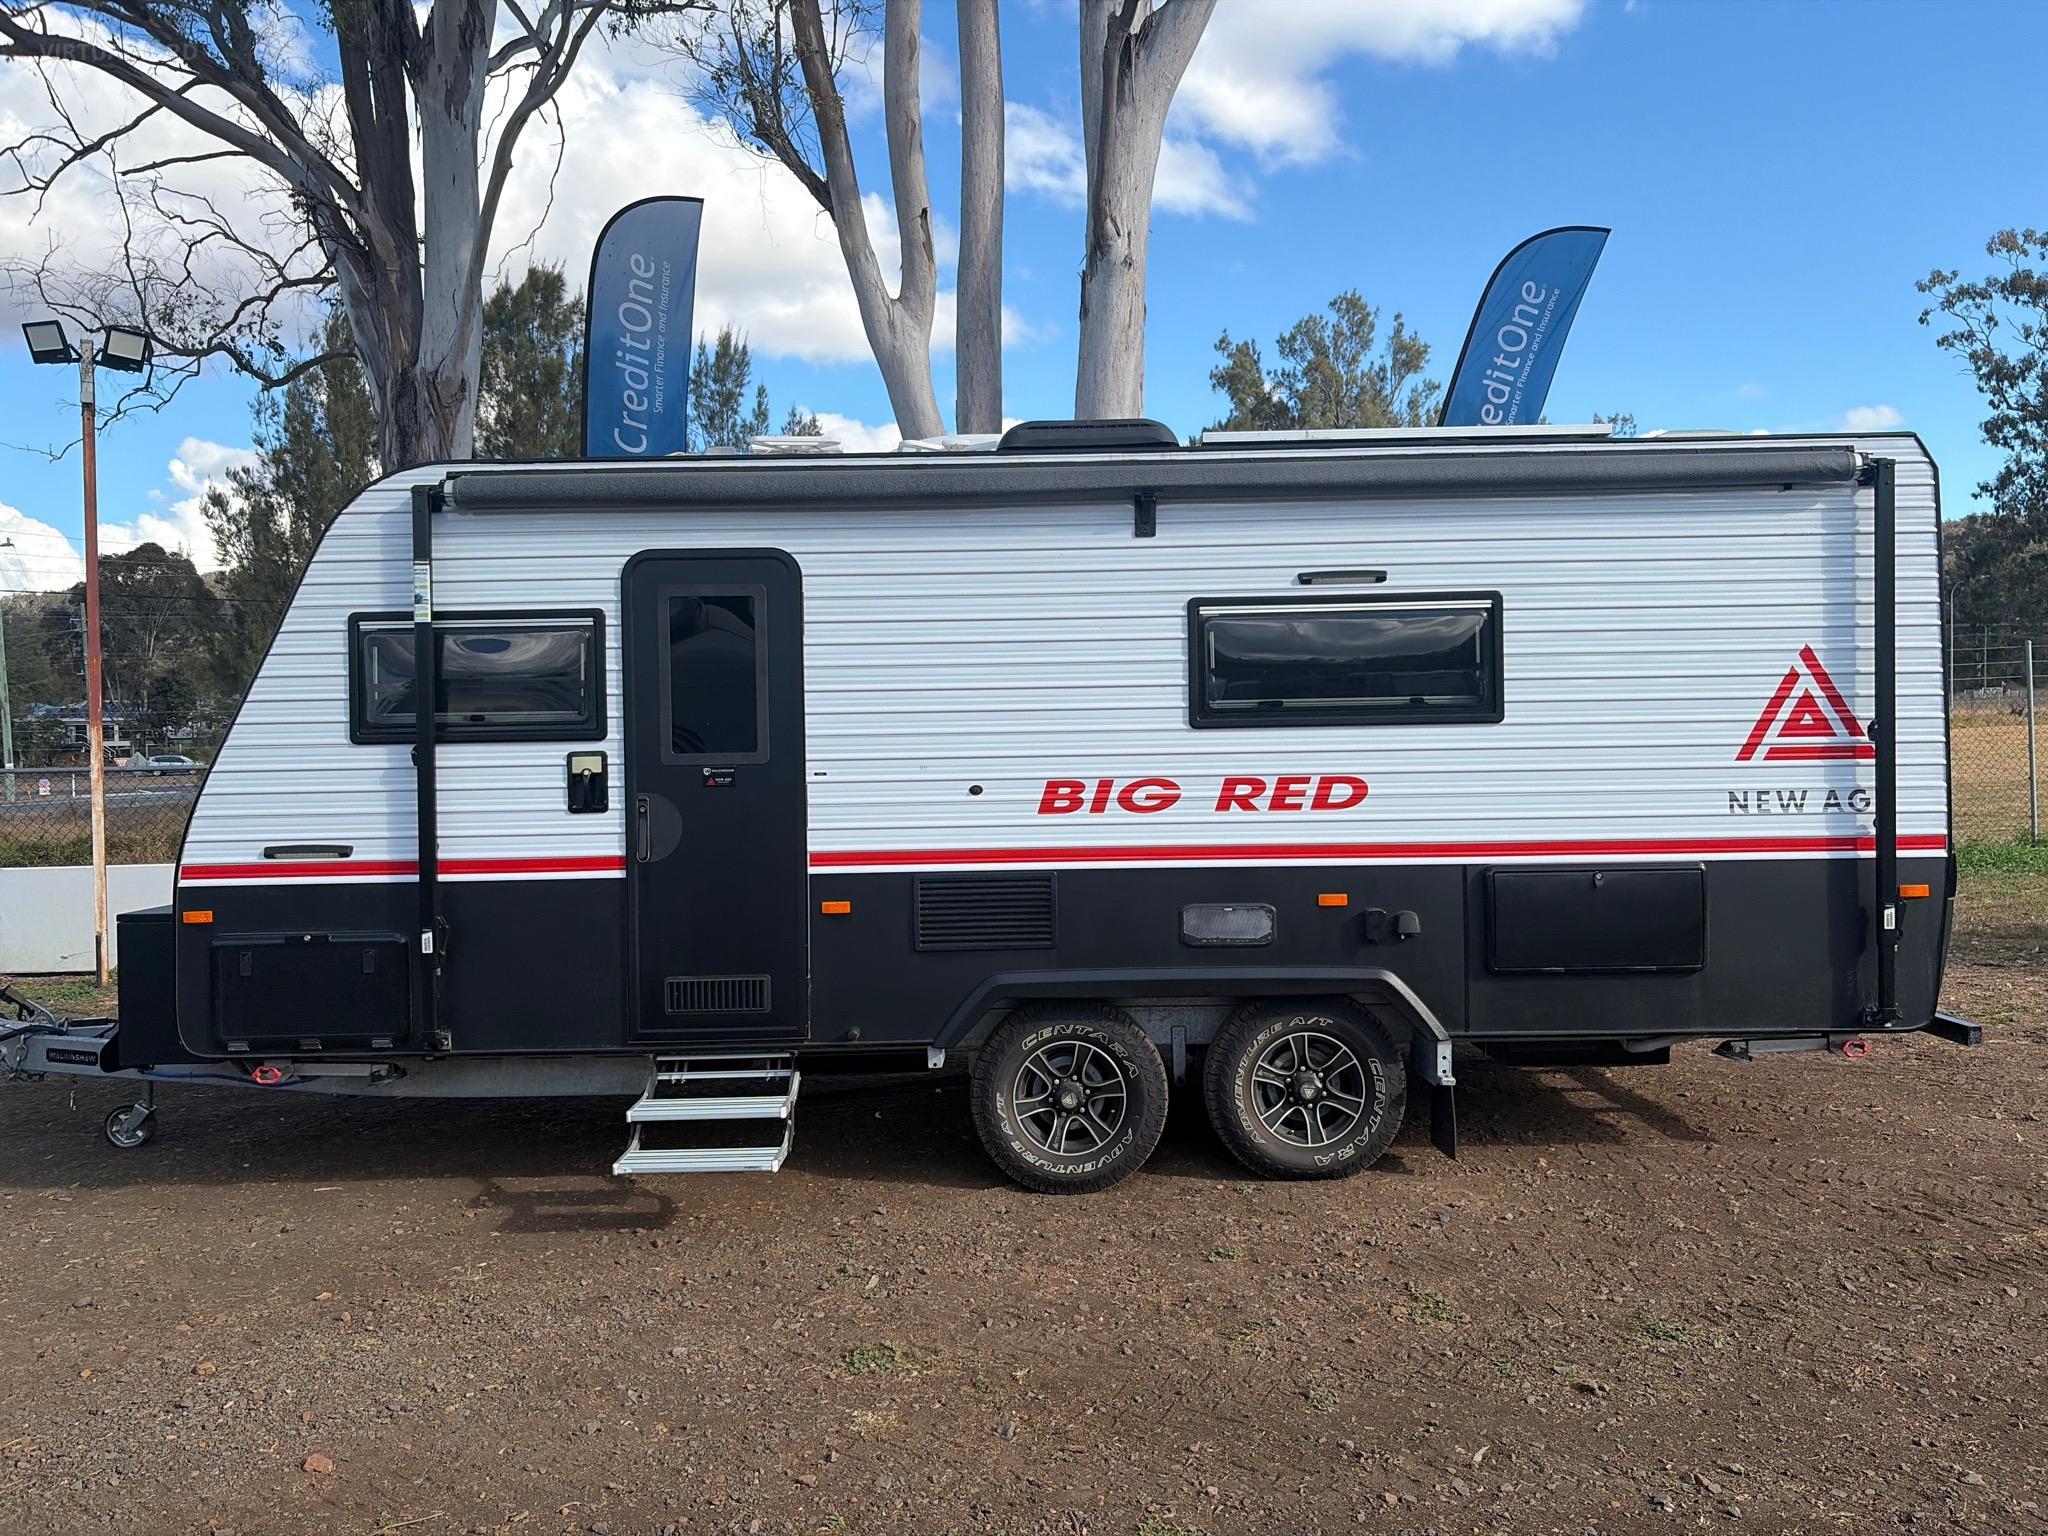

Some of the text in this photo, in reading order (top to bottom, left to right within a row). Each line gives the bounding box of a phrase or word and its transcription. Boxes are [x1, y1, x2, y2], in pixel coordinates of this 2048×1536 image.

[613, 252, 655, 454] CreditOne
[653, 260, 671, 415] Smarter Finance and Insurance
[1478, 280, 1546, 425] editOne
[1516, 352, 1535, 388] Finance
[1531, 333, 1542, 352] and
[1537, 288, 1560, 333] Insurance
[1036, 775, 1369, 815] BIG RED
[1727, 788, 1872, 814] NEW AG
[1021, 1023, 1139, 1079] CENTARA
[1232, 1016, 1335, 1144] ADVENTURE A/T
[1010, 1127, 1133, 1174] ADVENTURE
[1313, 1058, 1387, 1167] CENTARA
